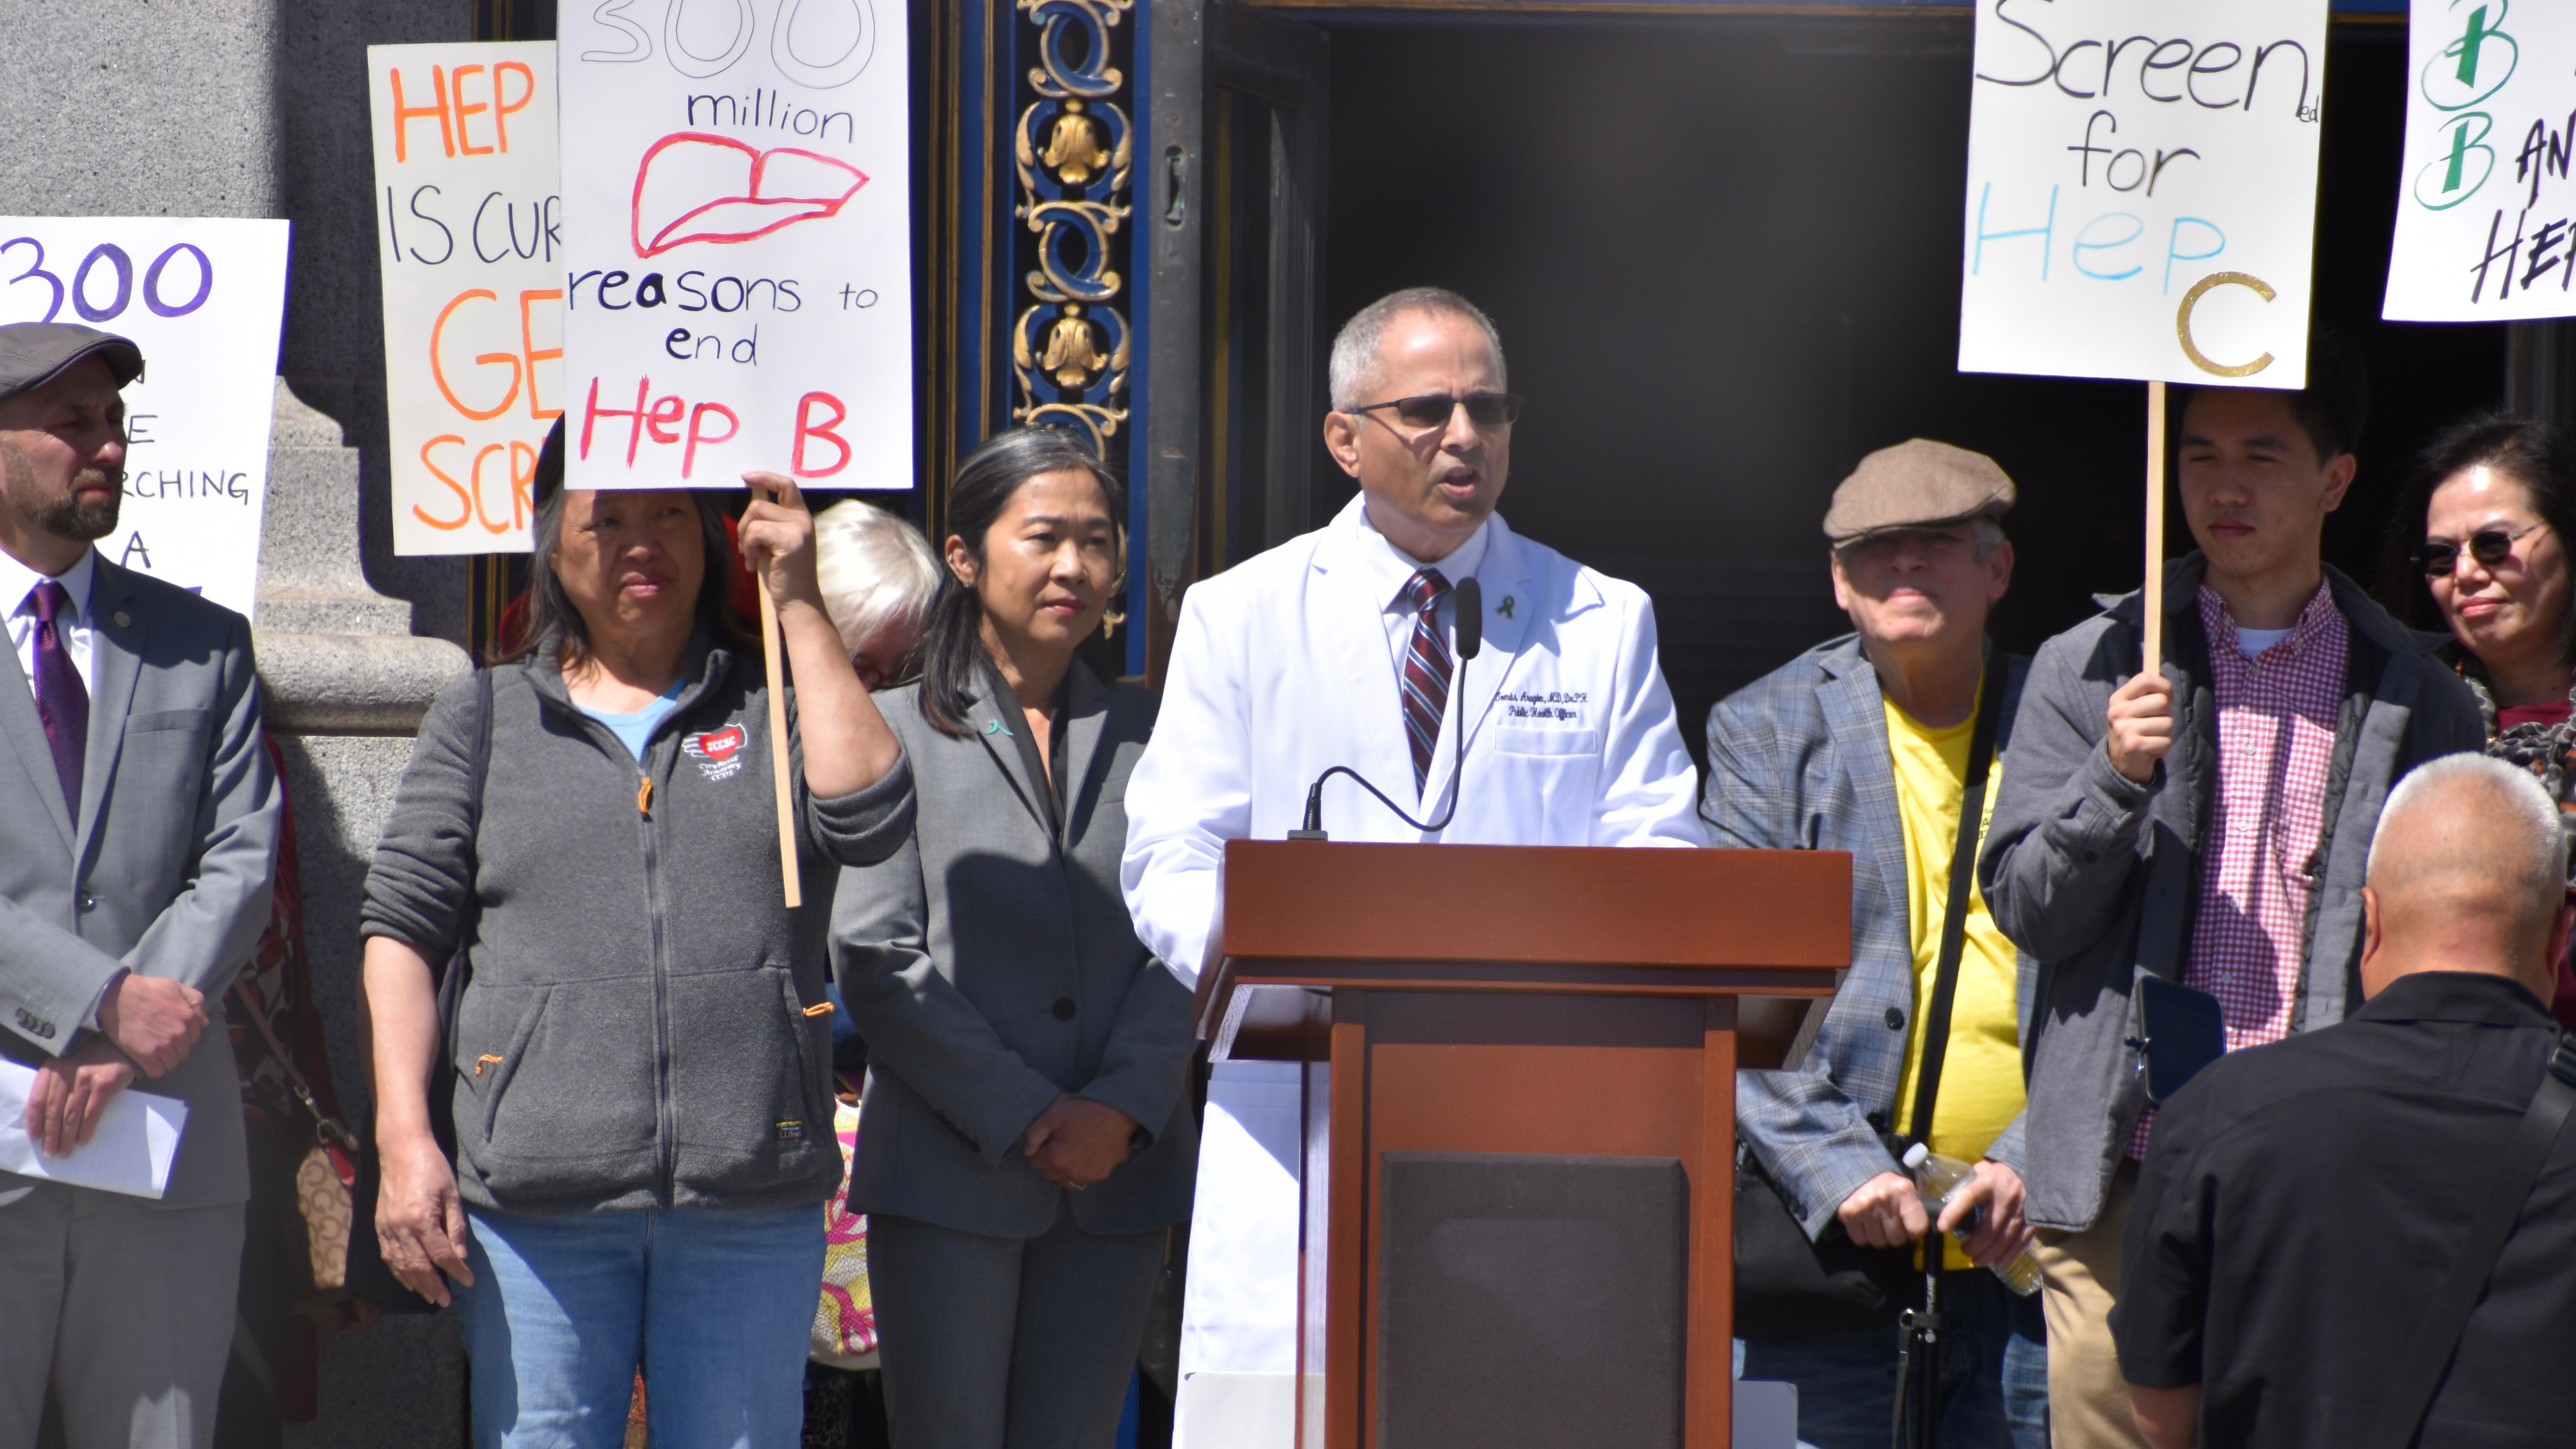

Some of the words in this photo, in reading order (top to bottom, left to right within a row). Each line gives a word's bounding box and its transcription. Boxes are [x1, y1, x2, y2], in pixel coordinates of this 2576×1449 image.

[390, 61, 534, 163] HEP
[687, 88, 853, 143] million
[2067, 110, 2201, 198] for
[2414, 111, 2495, 211] B
[387, 185, 453, 264] IS
[473, 192, 560, 263] CUR
[0, 237, 213, 323] 300
[568, 270, 801, 312] reasons
[839, 282, 878, 310] to
[1972, 182, 2226, 295] Hep
[2176, 271, 2277, 378] C
[430, 288, 564, 420] GE
[666, 323, 757, 366] end
[580, 374, 740, 479] Hep
[791, 391, 852, 478] B
[413, 434, 548, 534] SCR
[1508, 706, 1529, 718] Public
[1530, 707, 1553, 718] Health
[1555, 708, 1577, 721] Officer
